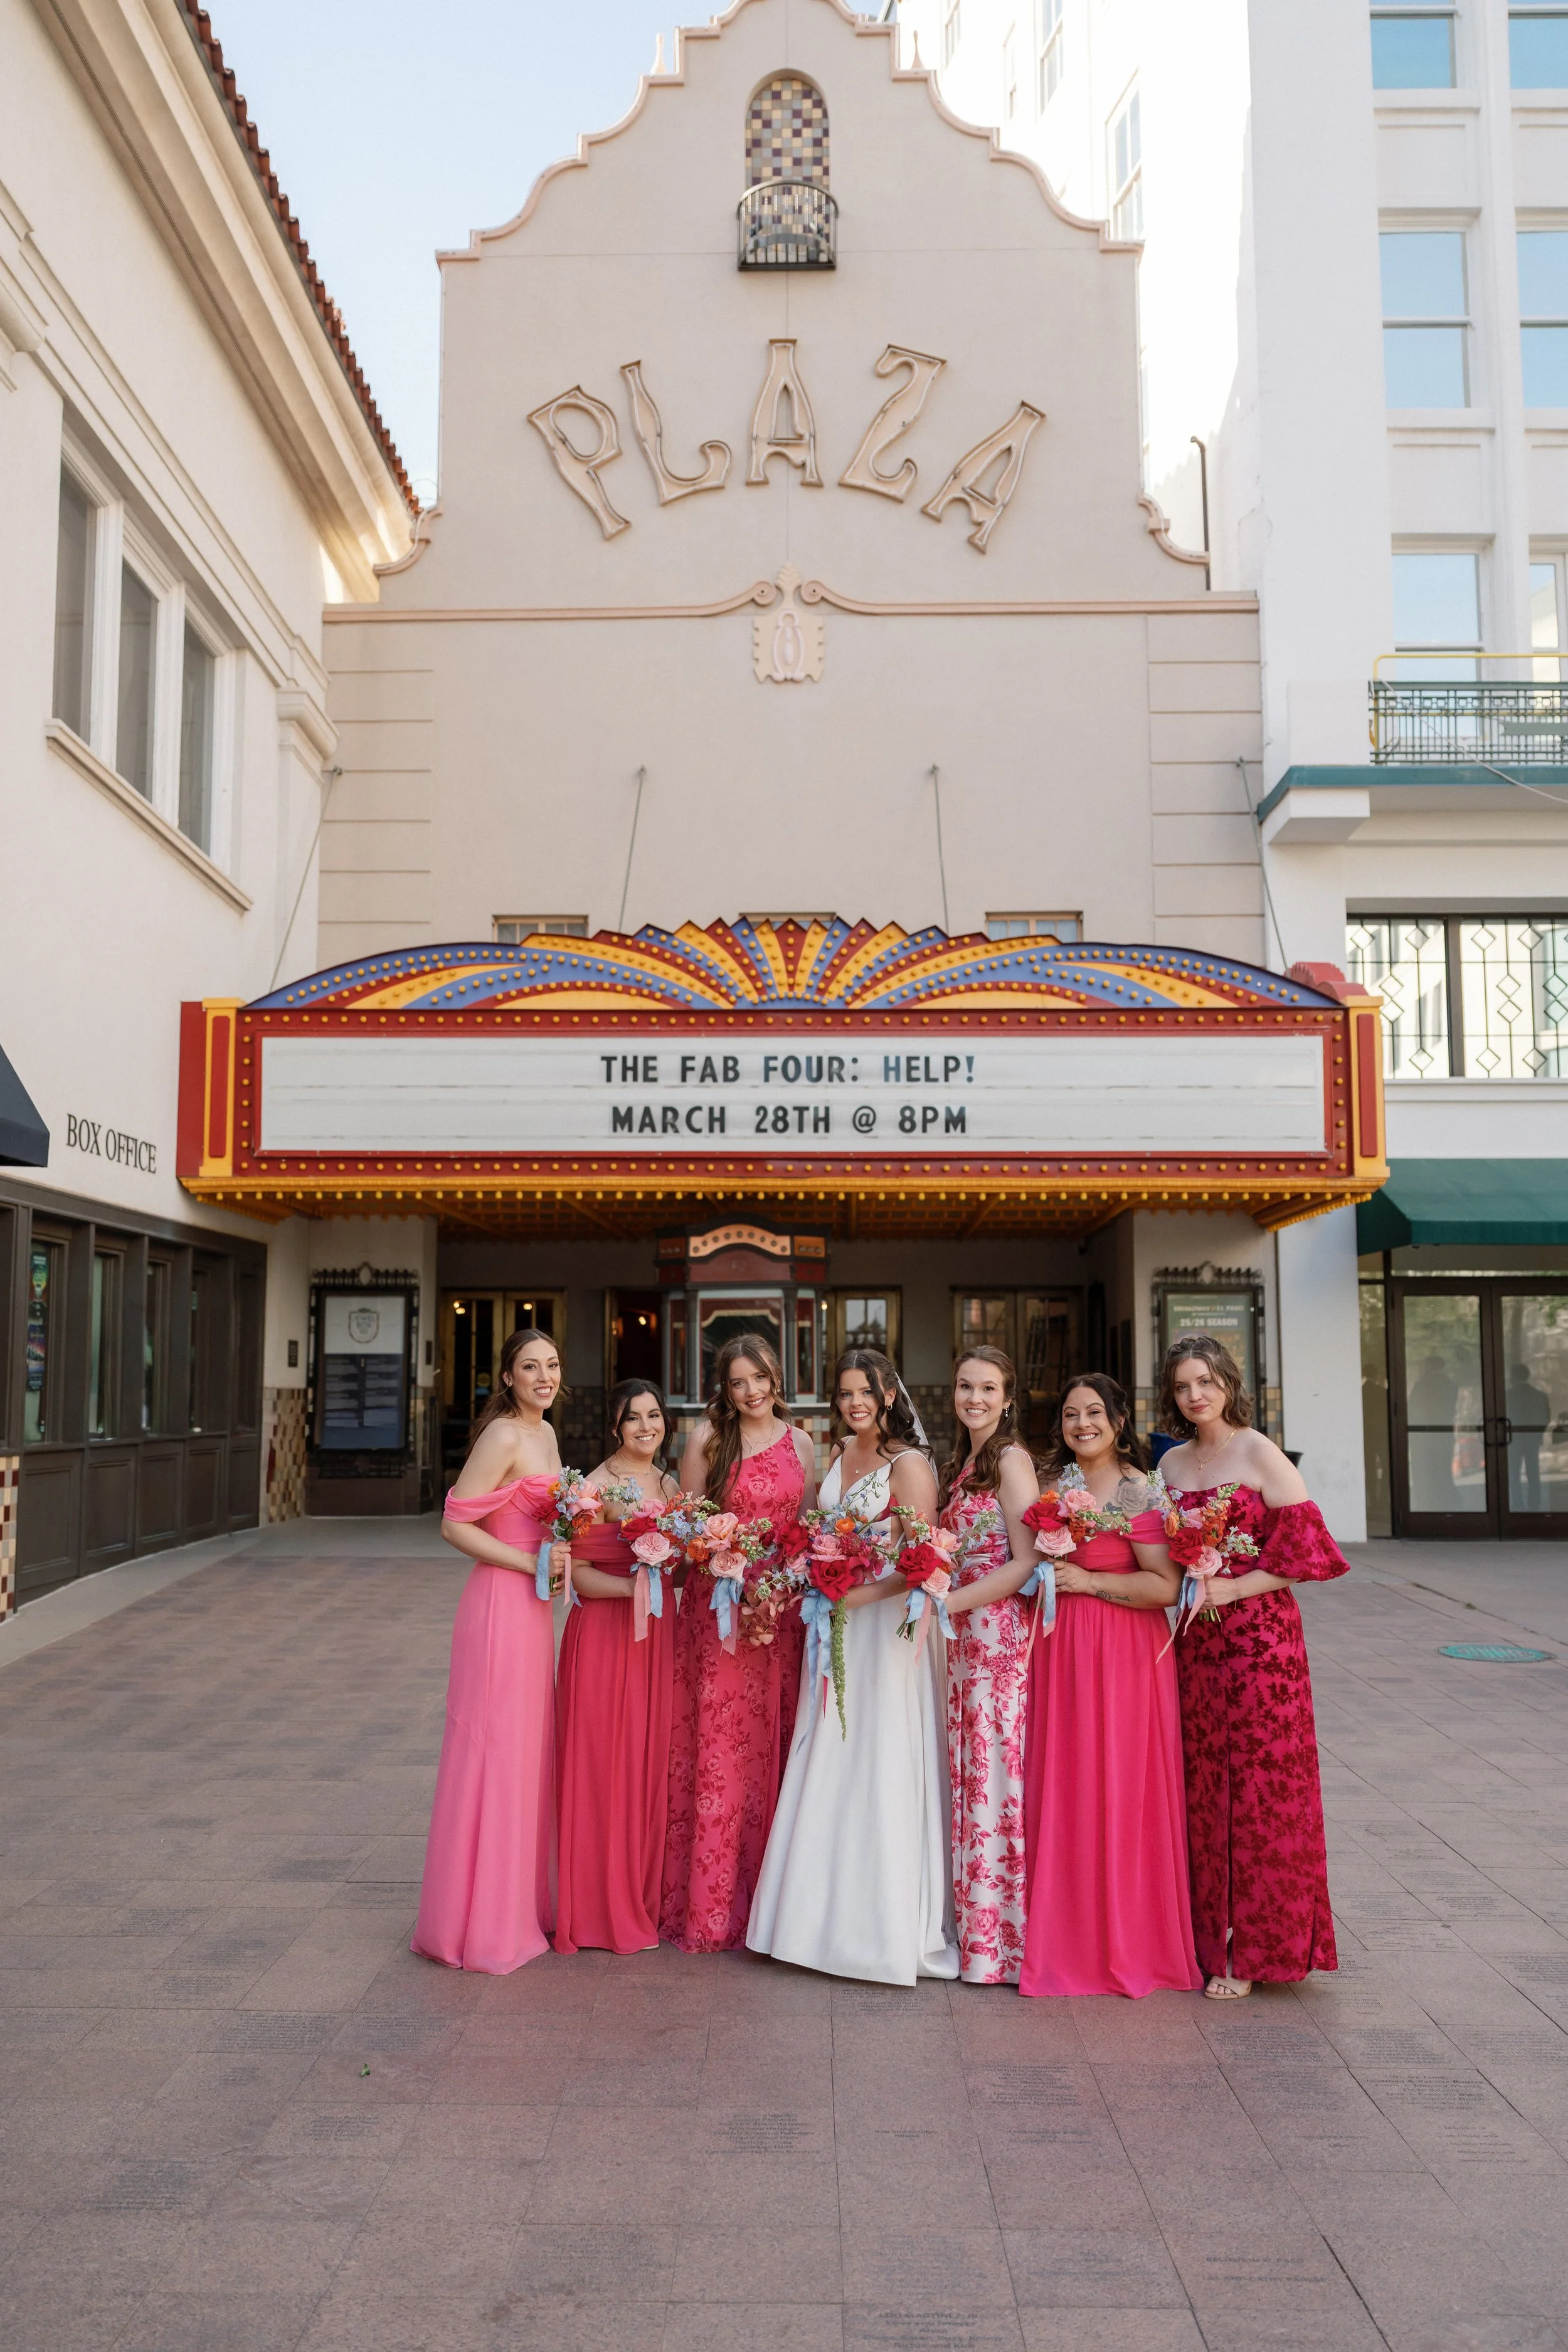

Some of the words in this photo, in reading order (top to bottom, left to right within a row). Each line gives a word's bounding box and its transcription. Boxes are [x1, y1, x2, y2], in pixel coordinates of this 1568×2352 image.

[527, 338, 1047, 554] PLAZA
[600, 1056, 658, 1083] THE
[681, 1056, 741, 1083] FAB
[763, 1056, 859, 1083] FOUR:
[884, 1056, 975, 1083] HELP!
[612, 1106, 726, 1134] MARCH
[755, 1106, 831, 1134] 28TH
[852, 1106, 876, 1133] @
[898, 1106, 967, 1134] 8PM
[66, 1113, 102, 1157] BOX
[105, 1129, 157, 1175] OFFICE
[1206, 1318, 1239, 1327] SEASON
